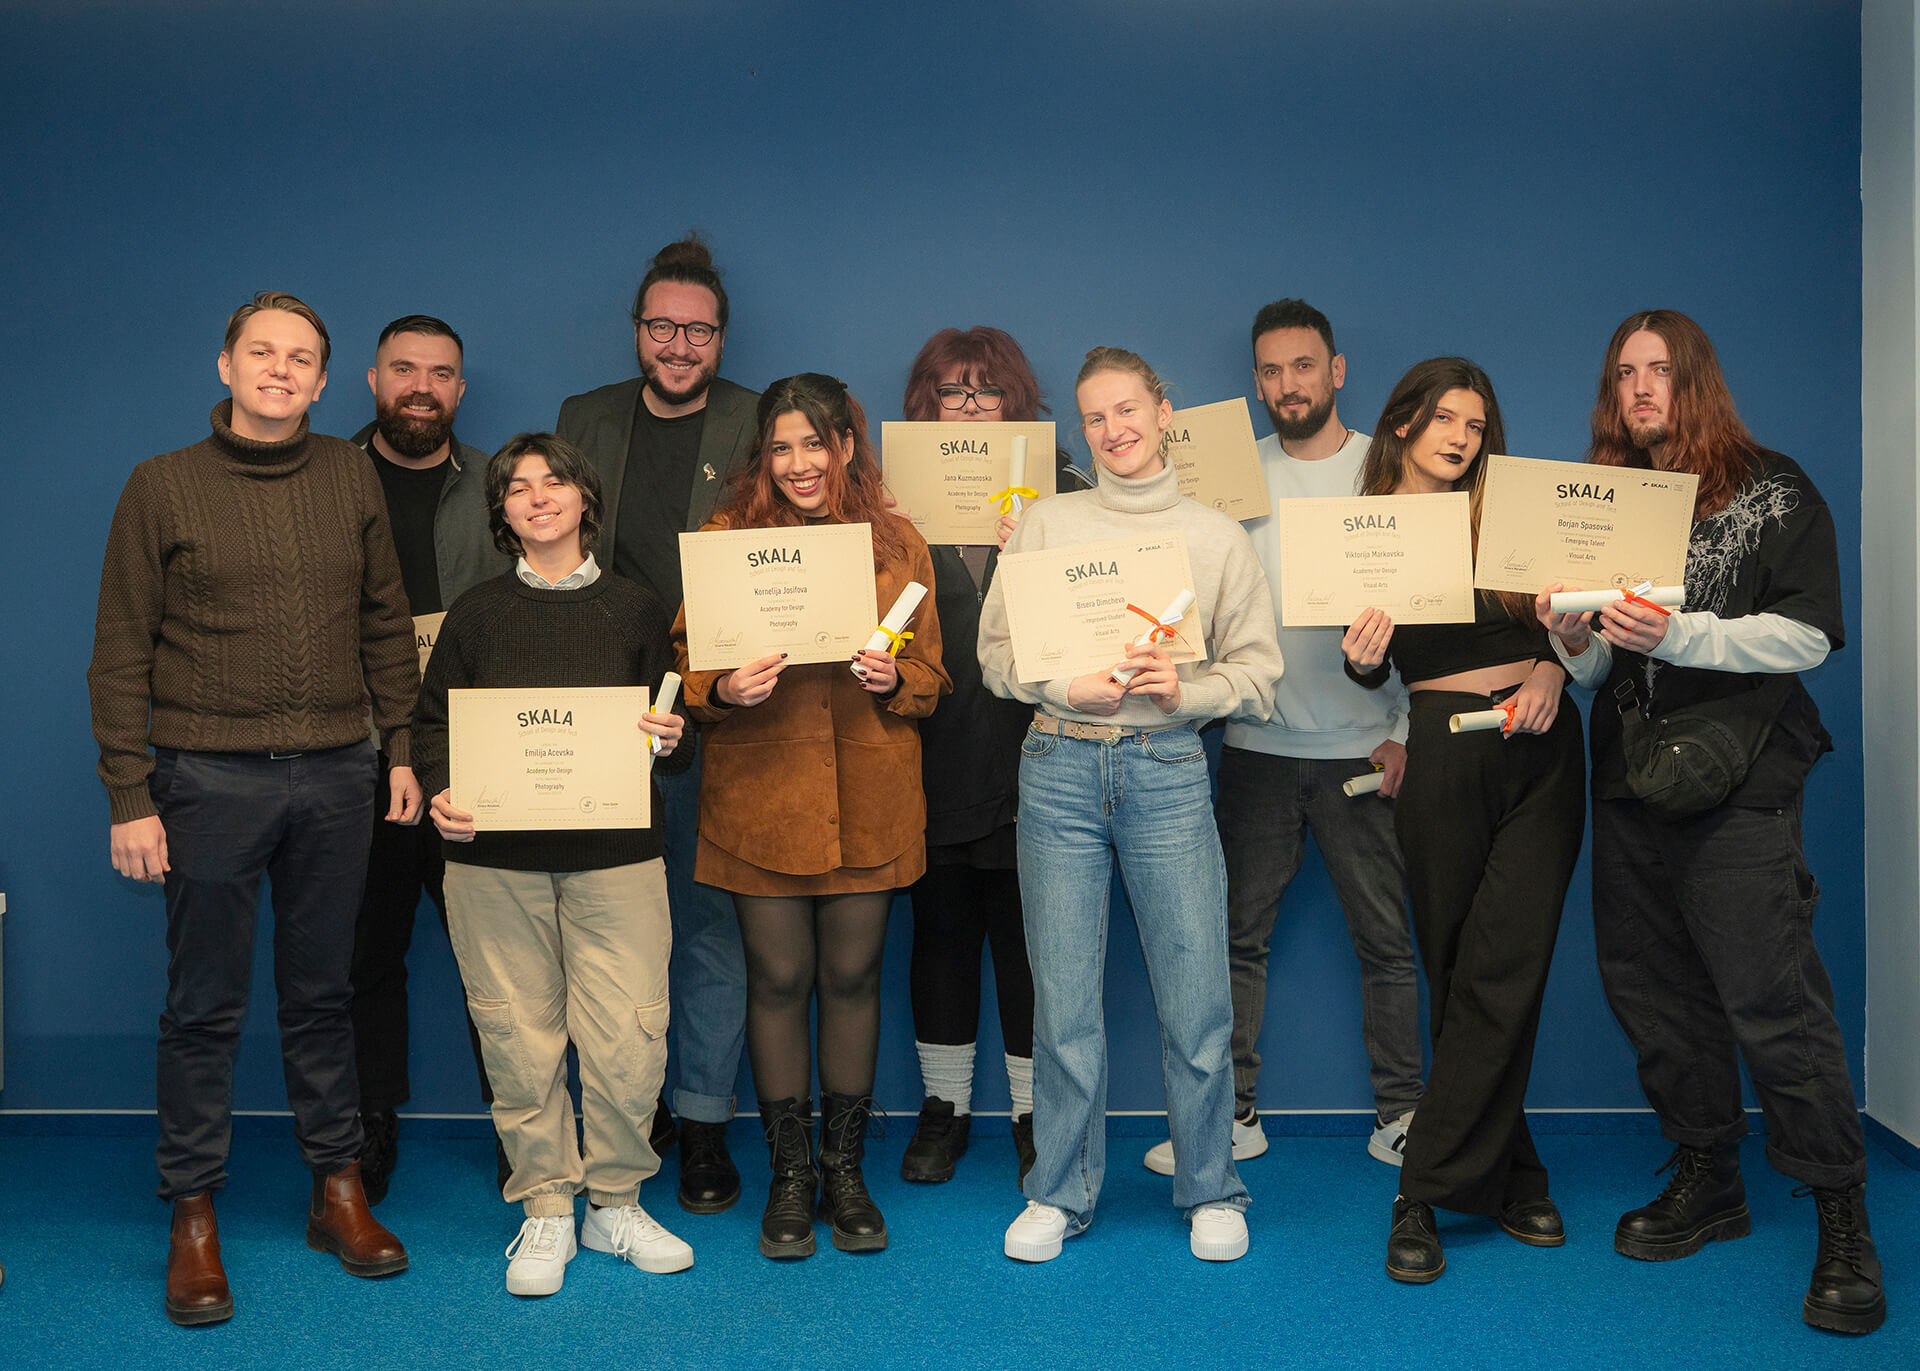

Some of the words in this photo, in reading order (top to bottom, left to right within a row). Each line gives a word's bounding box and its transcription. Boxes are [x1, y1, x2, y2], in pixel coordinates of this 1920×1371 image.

[1164, 429, 1190, 443] ALA
[940, 440, 988, 456] SKALA
[1556, 483, 1615, 503] SKALA
[1343, 514, 1396, 532] SKALA
[1558, 519, 1579, 529] Borjan
[1580, 521, 1614, 532] Spasovski
[1565, 537, 1589, 546] Emerging
[747, 548, 801, 567] SKALA
[1345, 551, 1370, 560] Viktorija
[1372, 550, 1404, 558] Markovska
[1065, 561, 1118, 582] SKALA
[754, 587, 781, 596] Kornelija
[783, 586, 808, 594] Josifova
[1076, 601, 1095, 609] Bisera
[1096, 597, 1125, 607] Dimcheva
[769, 620, 798, 628] Photography
[517, 709, 572, 727] SKALA
[525, 749, 546, 758] Emilija
[548, 748, 574, 756] Acevska
